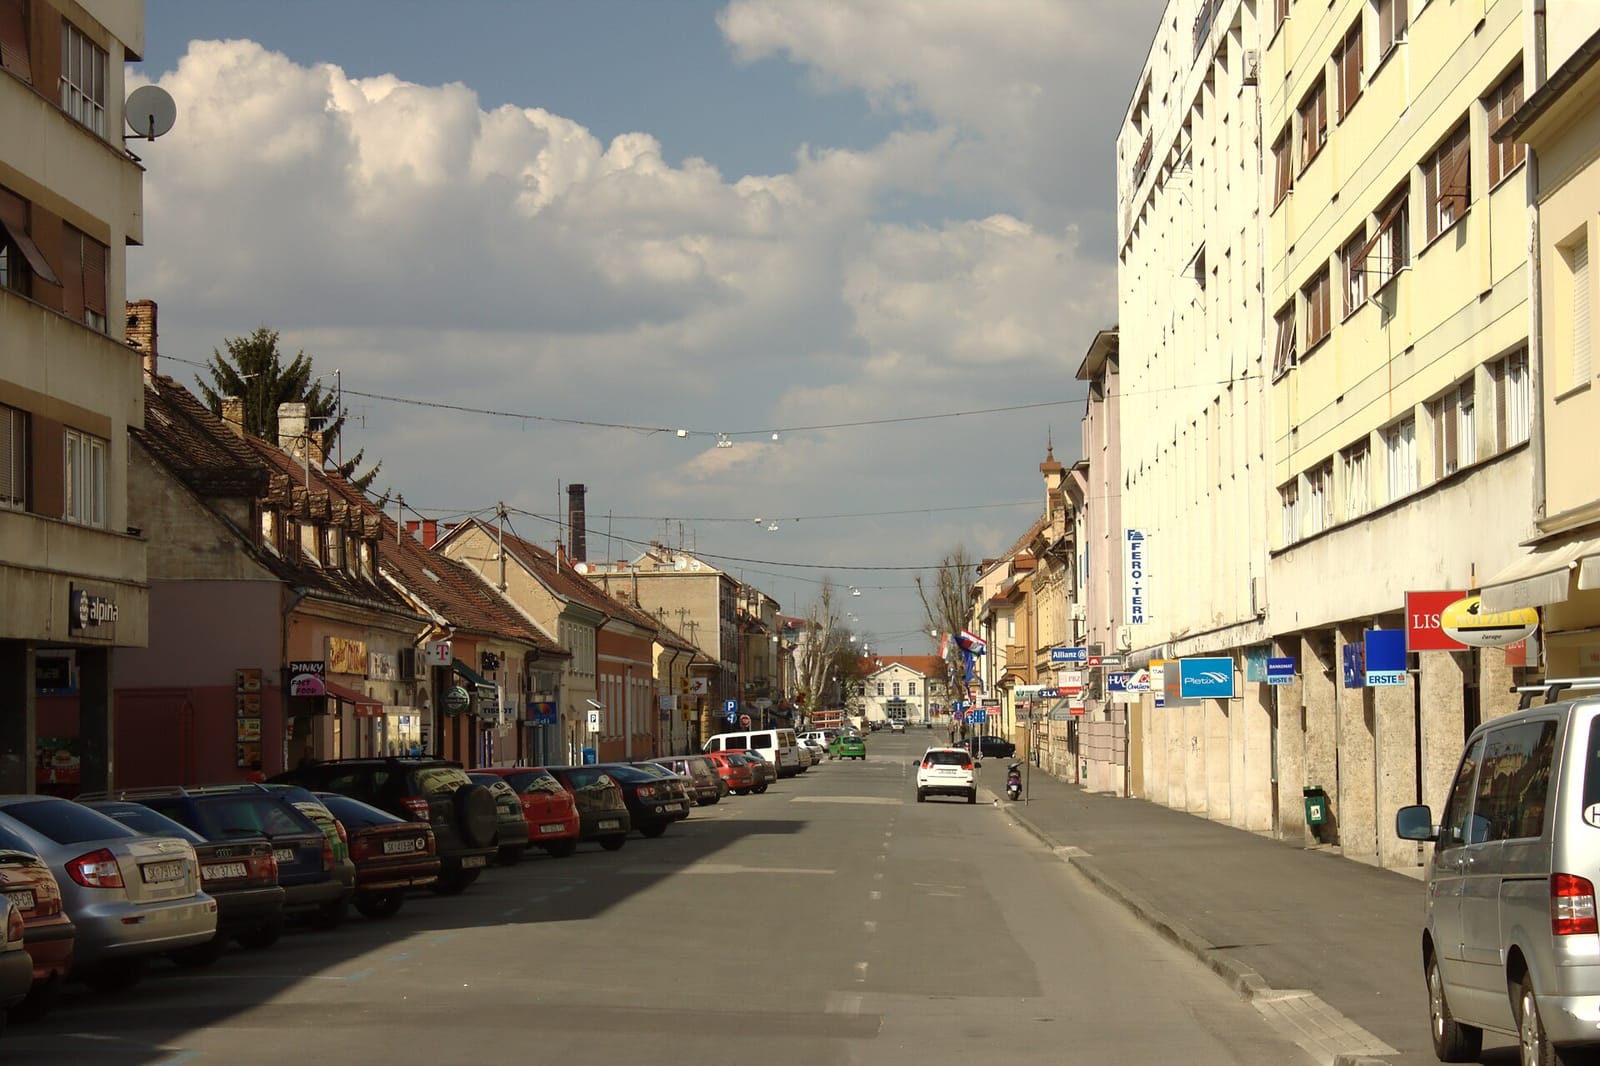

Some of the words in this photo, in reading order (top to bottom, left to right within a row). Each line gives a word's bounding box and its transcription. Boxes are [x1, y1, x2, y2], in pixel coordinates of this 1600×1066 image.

[90, 597, 119, 626] alpina
[436, 644, 449, 661] T
[1053, 651, 1077, 659] Allianz
[291, 663, 324, 673] PINKY
[1184, 677, 1215, 685] Pletix
[1269, 676, 1287, 684] ERSTE
[1368, 675, 1398, 684] ERSTE
[727, 701, 735, 711] P
[206, 865, 217, 877] SK
